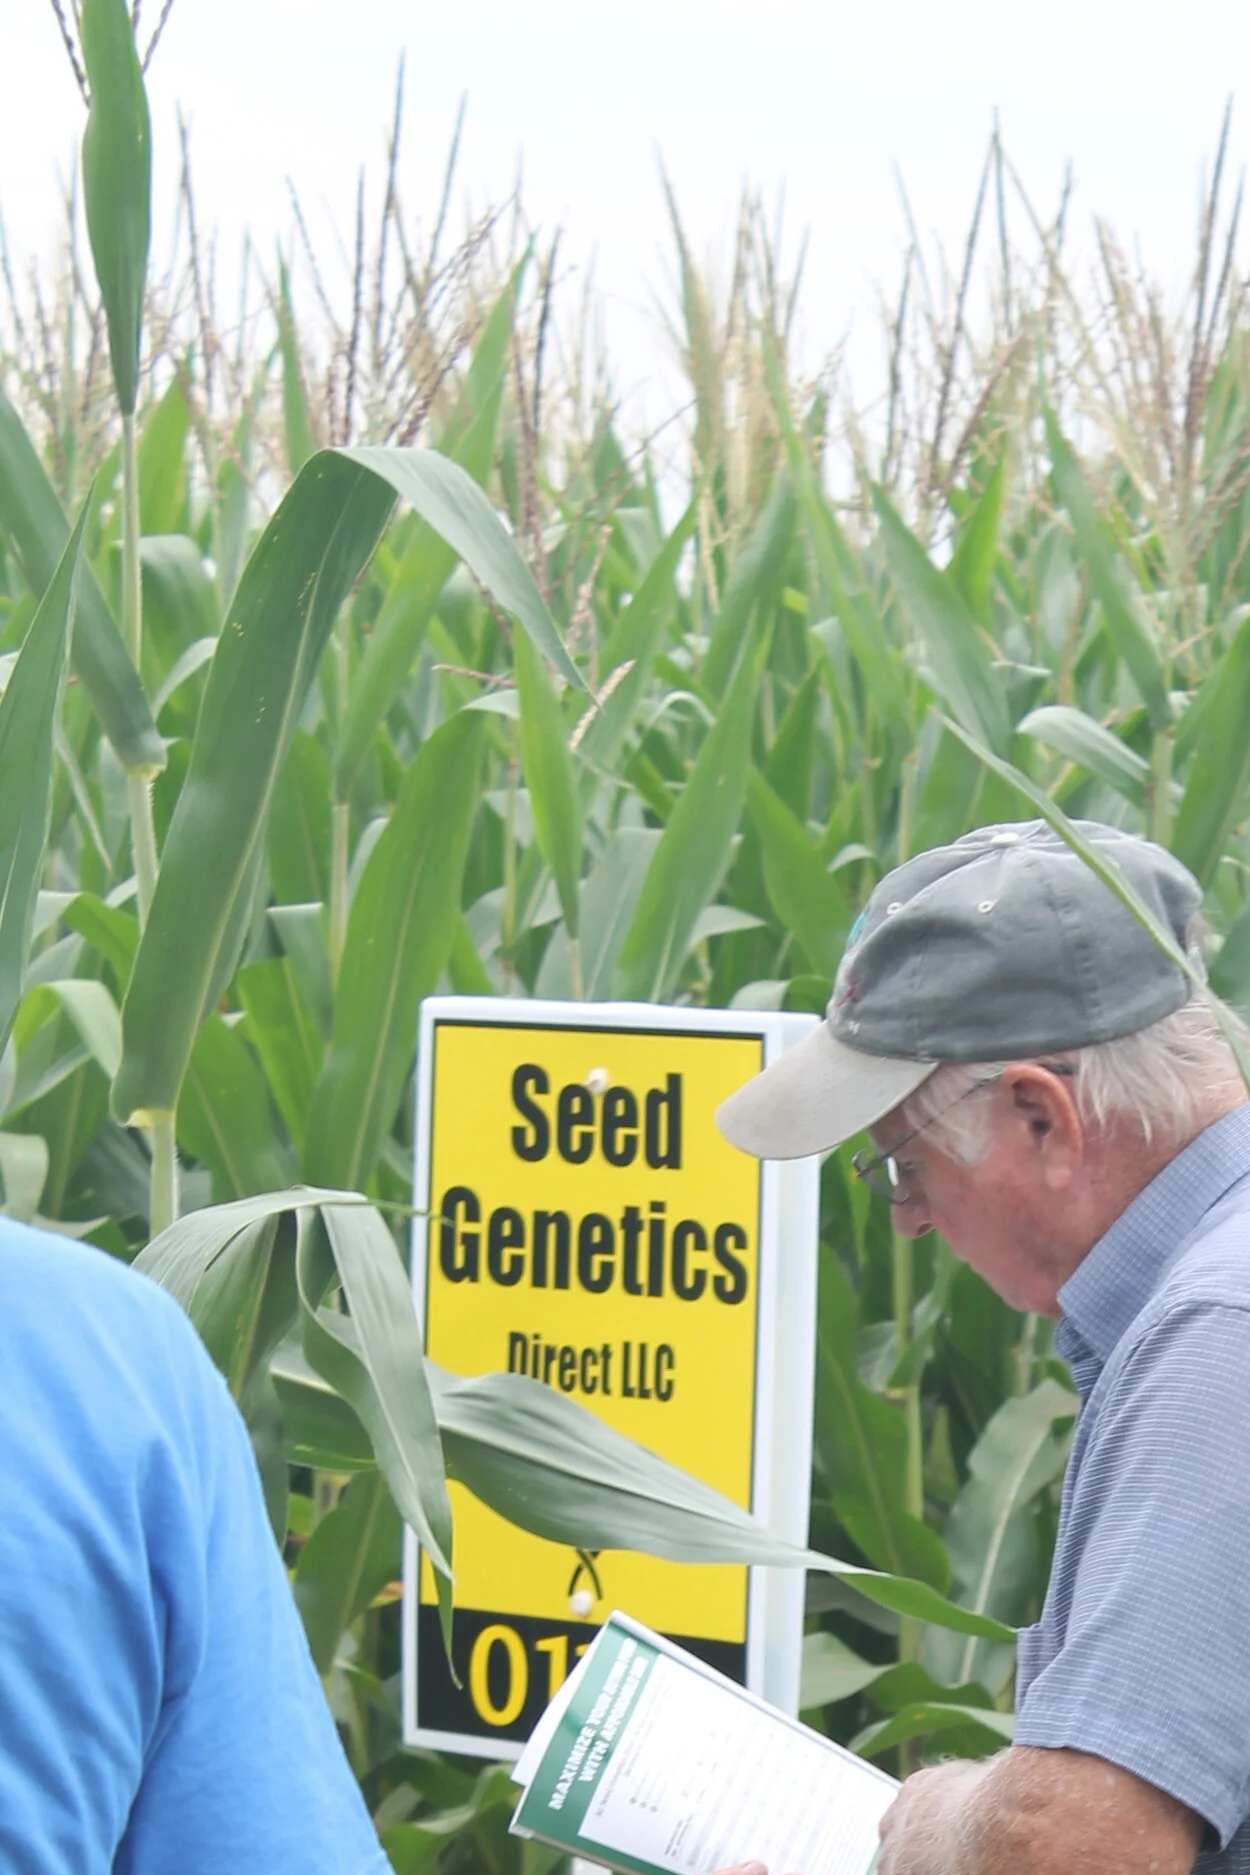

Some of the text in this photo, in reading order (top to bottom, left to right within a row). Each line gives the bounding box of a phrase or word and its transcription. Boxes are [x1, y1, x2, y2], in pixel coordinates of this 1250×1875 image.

[511, 1063, 682, 1170] Seed
[440, 1186, 748, 1305] Genetics
[507, 1331, 676, 1402] Direct LLC
[469, 1624, 592, 1727] 01
[547, 1725, 597, 1810] MAXIMIZE
[577, 1739, 610, 1782] WITH
